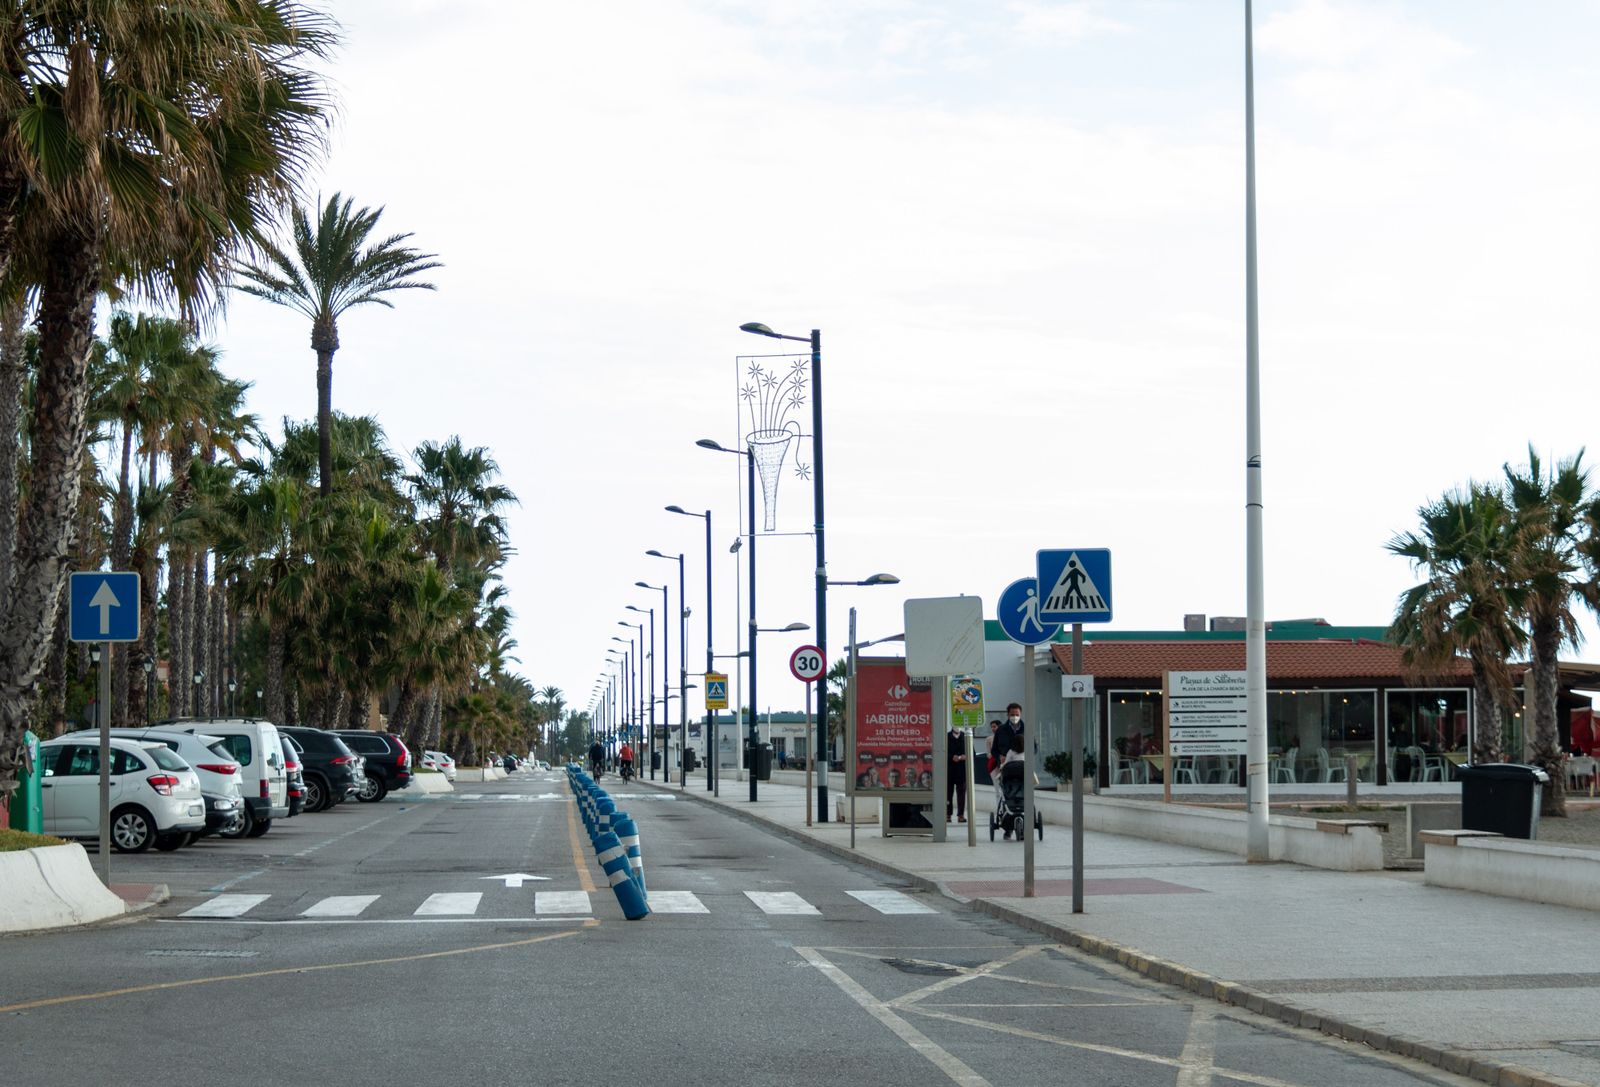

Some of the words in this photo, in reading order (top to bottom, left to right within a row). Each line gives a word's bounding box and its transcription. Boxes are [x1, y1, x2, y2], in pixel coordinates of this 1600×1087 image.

[798, 656, 819, 671] 30
[1180, 675, 1202, 686] Playas
[1203, 676, 1211, 684] de
[1212, 673, 1246, 684] Salobreña
[865, 714, 930, 725] ¡ABRIMOS!
